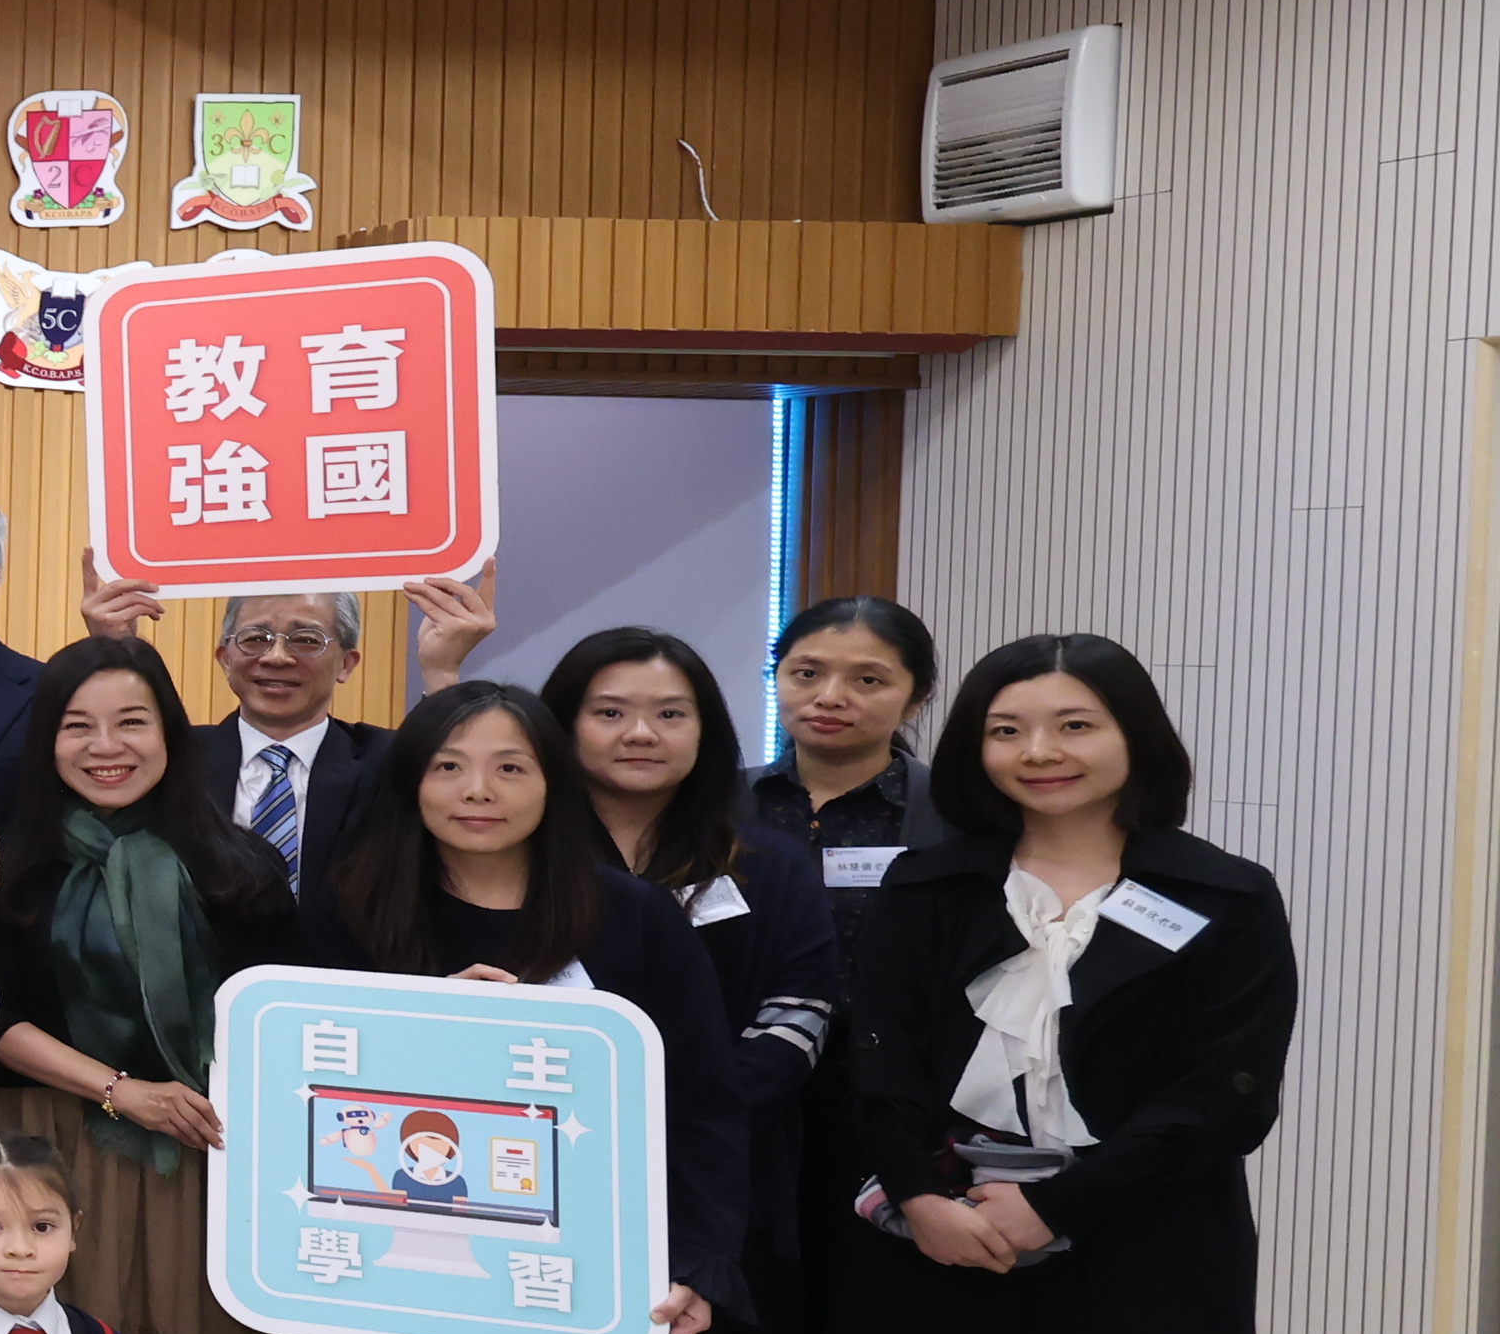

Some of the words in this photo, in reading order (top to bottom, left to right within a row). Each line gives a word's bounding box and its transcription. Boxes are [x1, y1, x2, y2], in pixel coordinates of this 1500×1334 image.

[210, 134, 225, 156] 3
[268, 134, 287, 154] C
[47, 166, 62, 188] 2
[73, 165, 93, 187] C
[41, 308, 77, 331] 5C
[164, 324, 405, 423] 教育
[167, 430, 408, 526] 強國
